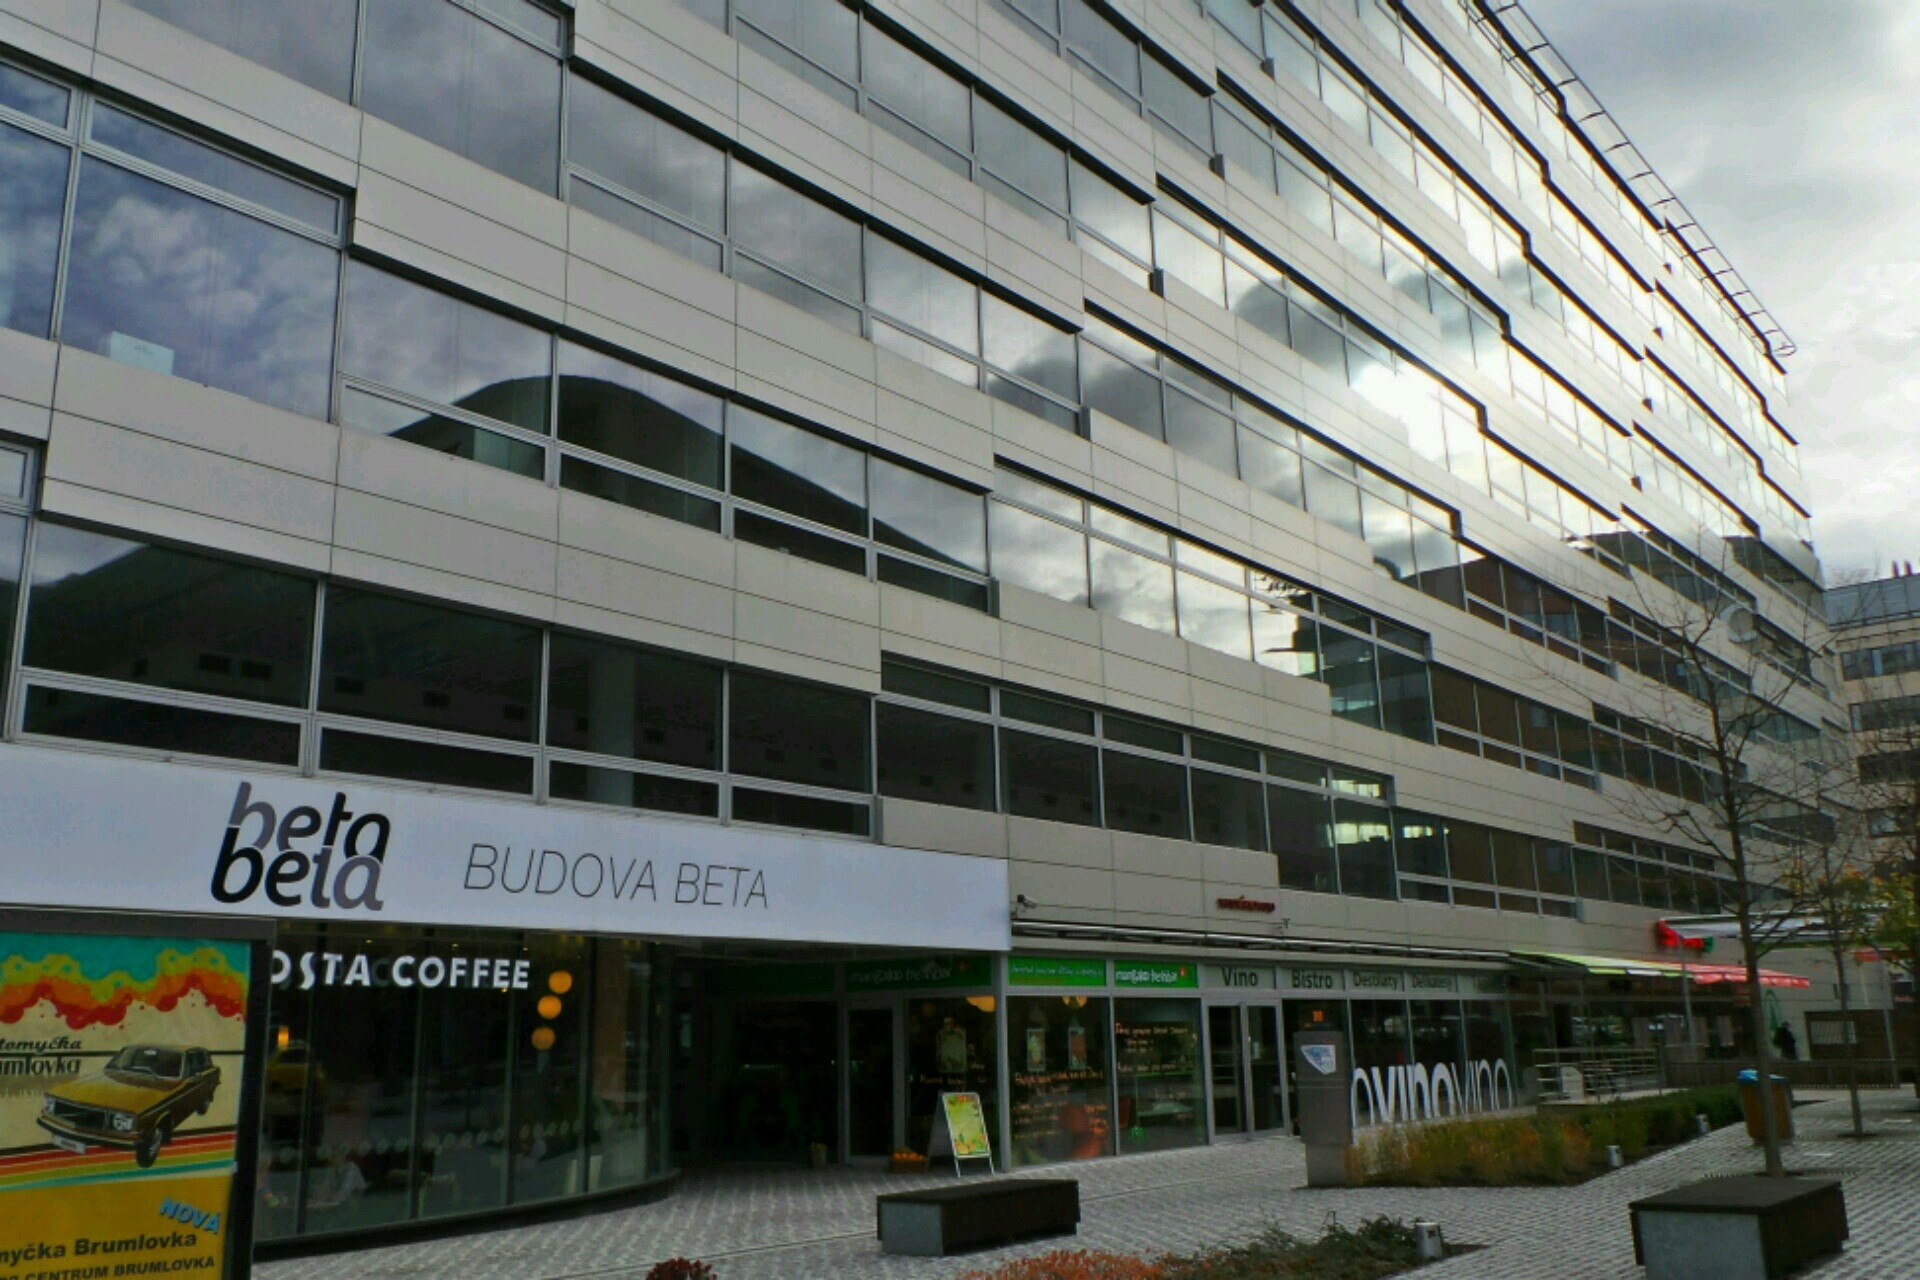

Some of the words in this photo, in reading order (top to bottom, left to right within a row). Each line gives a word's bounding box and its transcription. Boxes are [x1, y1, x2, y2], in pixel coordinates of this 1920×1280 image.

[229, 782, 390, 864] beta
[211, 827, 384, 911] beta
[464, 843, 656, 901] BUDOVA
[675, 863, 768, 908] BETA
[391, 955, 531, 989] COFFEE
[1291, 969, 1333, 989] Bistro
[74, 1232, 197, 1256] Brumlovka
[114, 1255, 215, 1276] BRUMLOVKA
